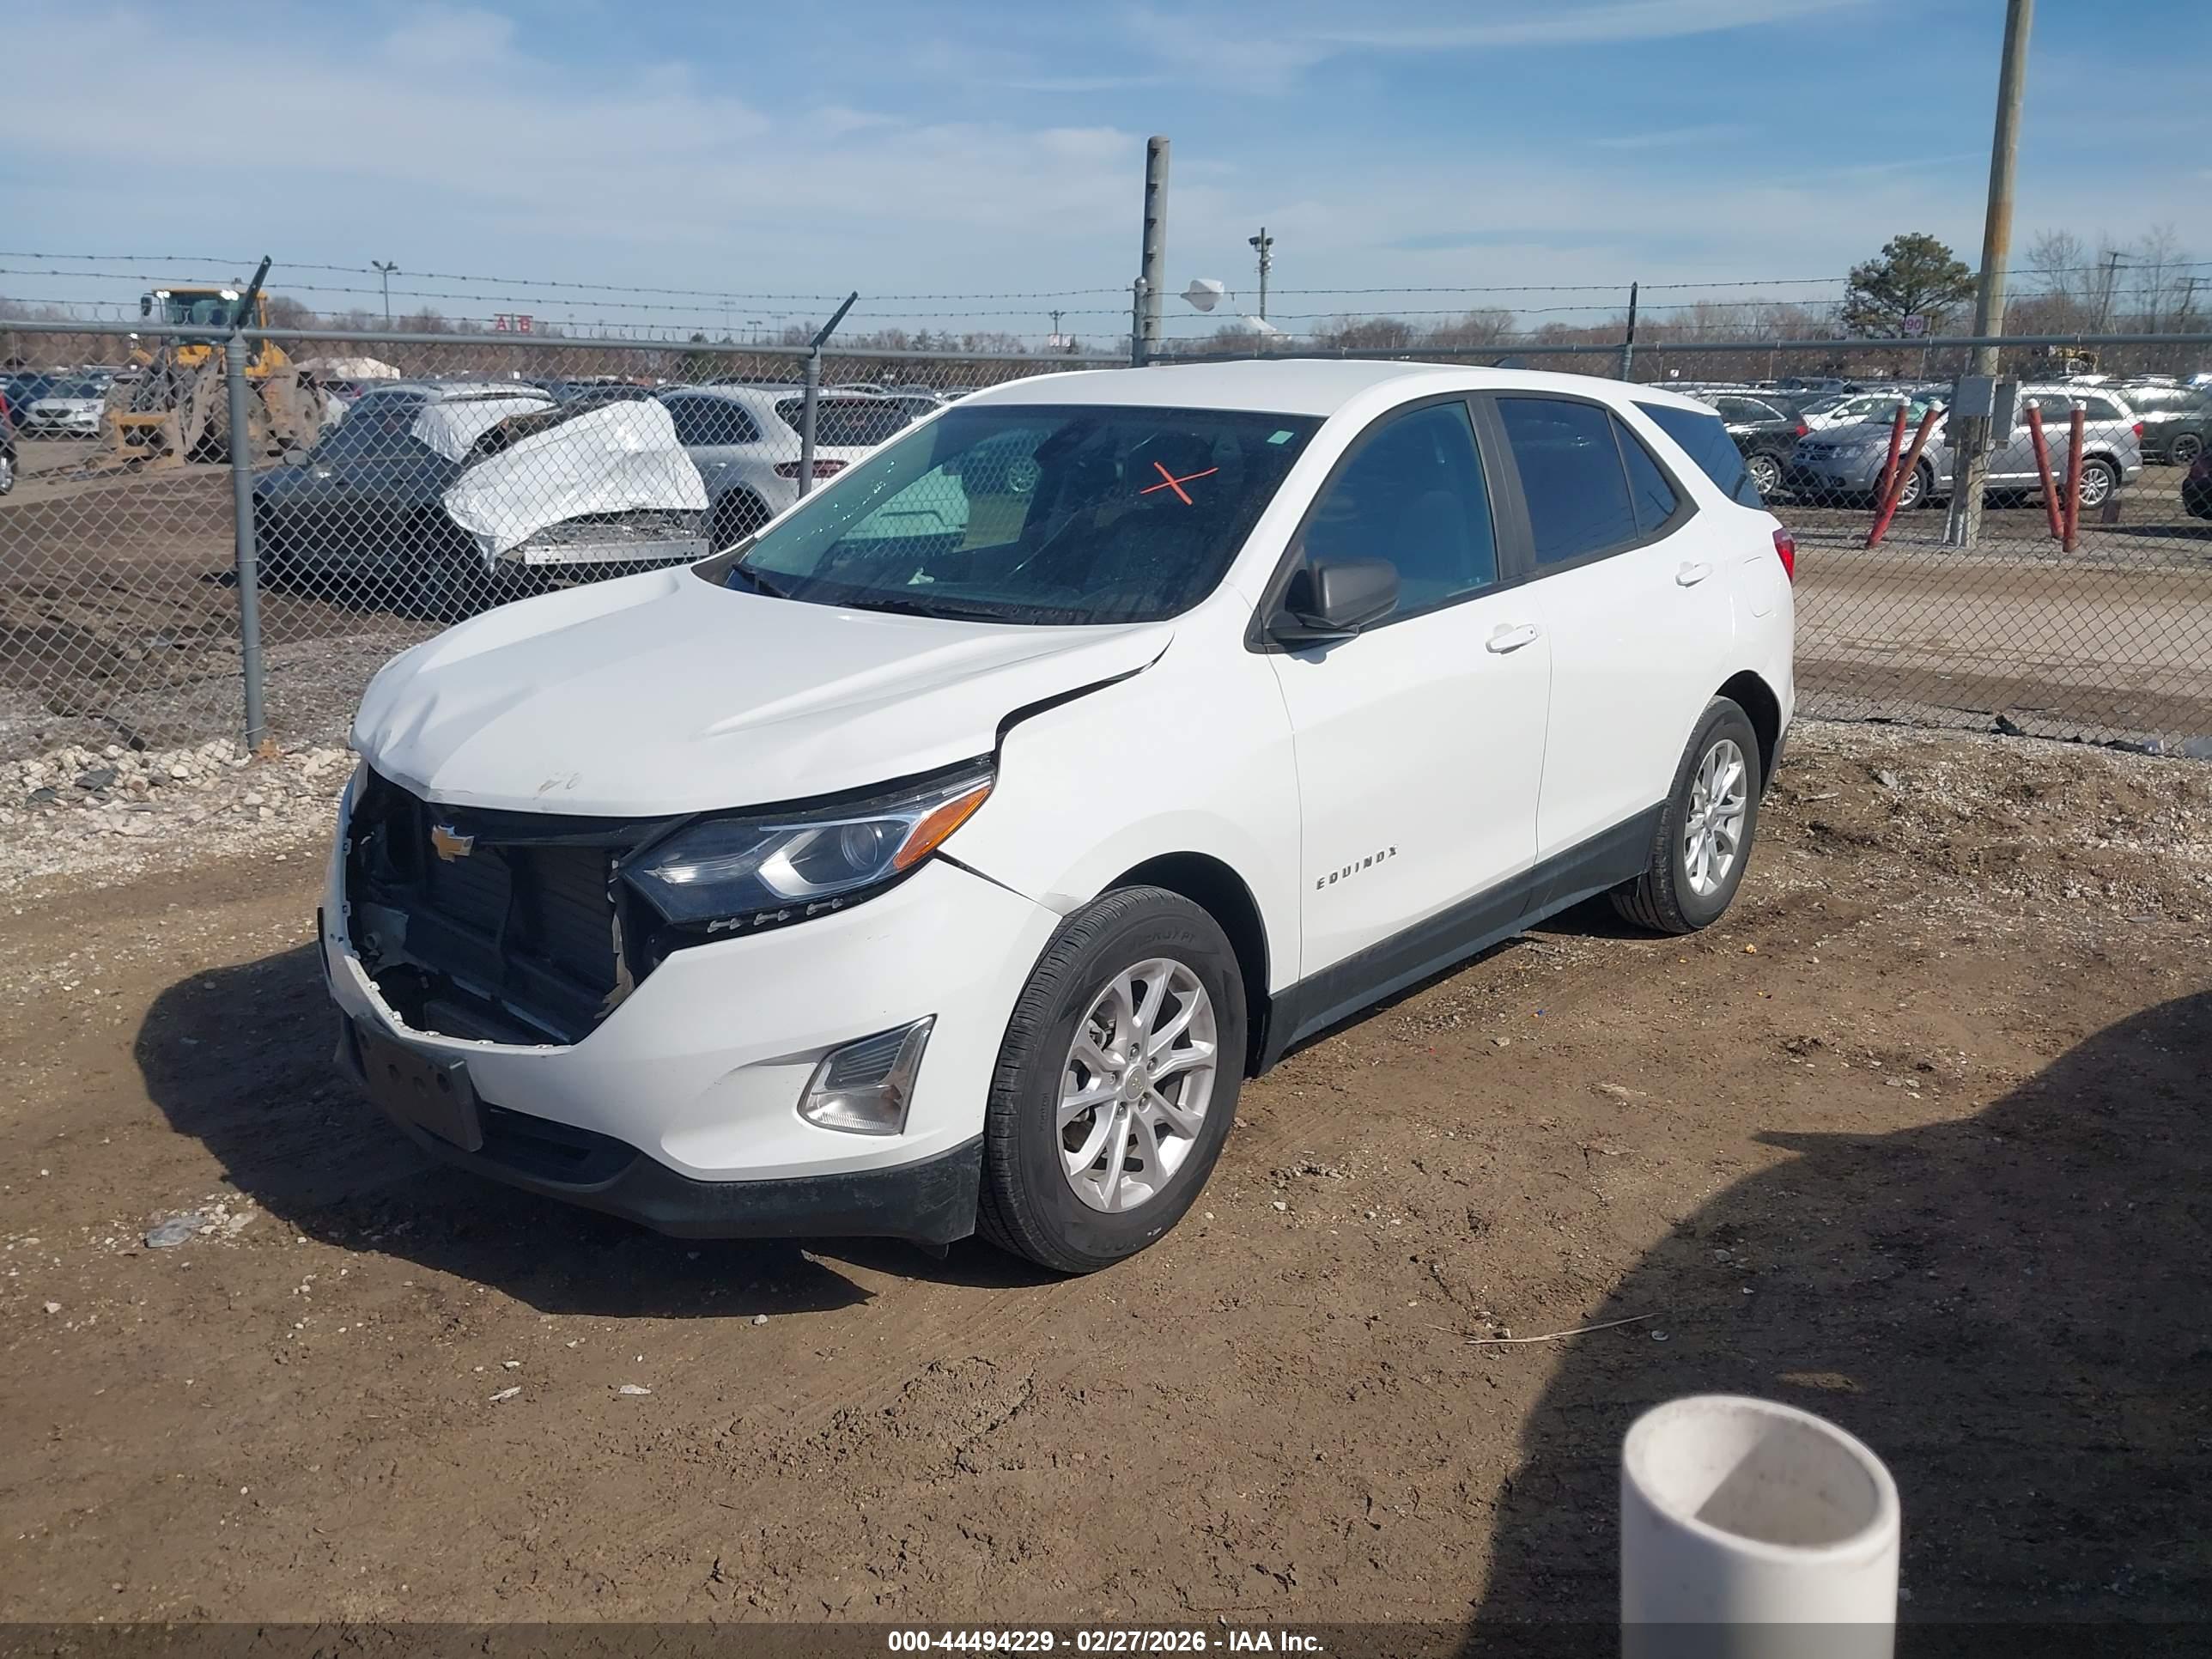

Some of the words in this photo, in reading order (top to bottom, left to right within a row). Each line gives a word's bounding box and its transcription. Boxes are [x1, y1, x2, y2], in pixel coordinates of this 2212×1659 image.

[495, 315, 507, 331] A
[1906, 319, 1922, 331] 90
[1316, 846, 1397, 890] EQUINOX
